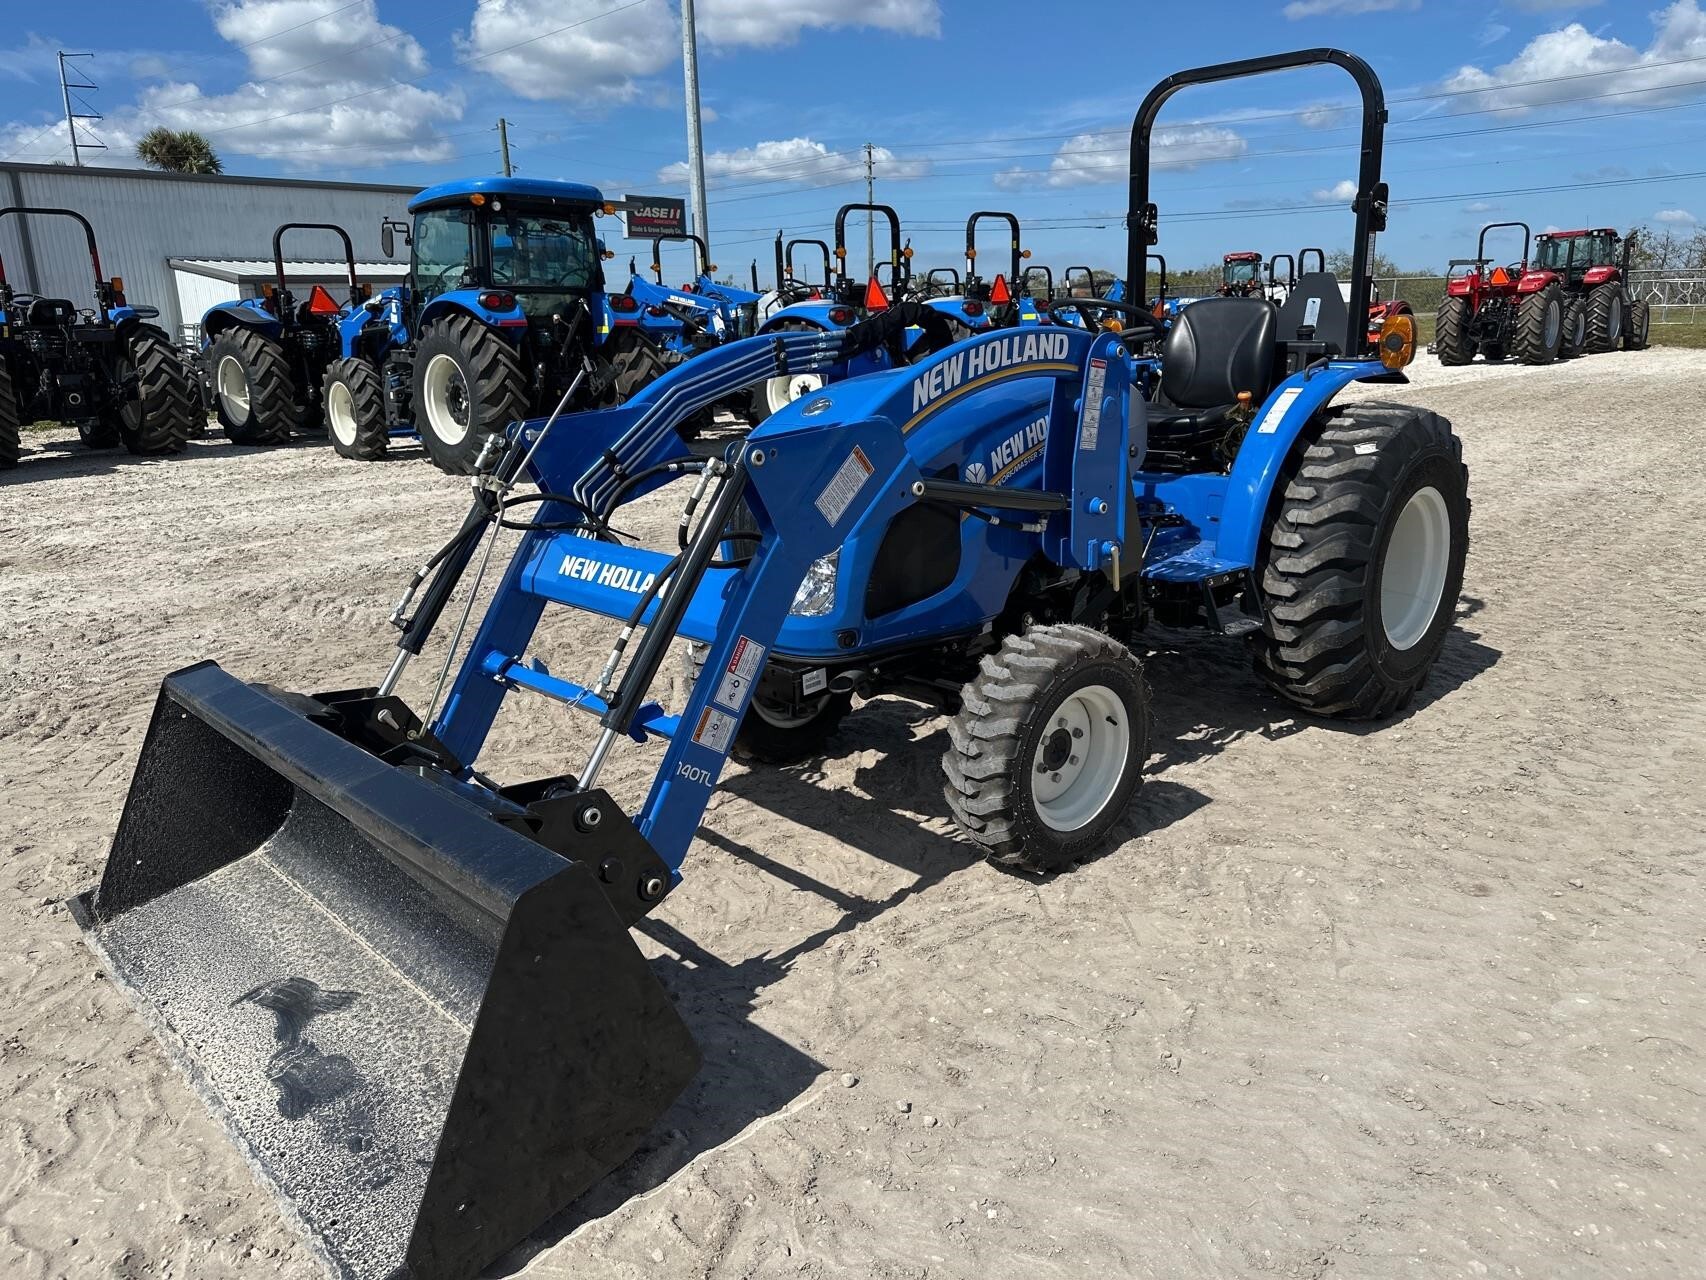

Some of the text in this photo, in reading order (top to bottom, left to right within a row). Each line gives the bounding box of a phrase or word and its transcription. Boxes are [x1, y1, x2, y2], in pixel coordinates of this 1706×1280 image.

[634, 207, 669, 218] CASE
[912, 333, 1070, 414] NEW HOLLAND
[990, 430, 1024, 475] NEW
[559, 554, 671, 599] NEW HOLLA
